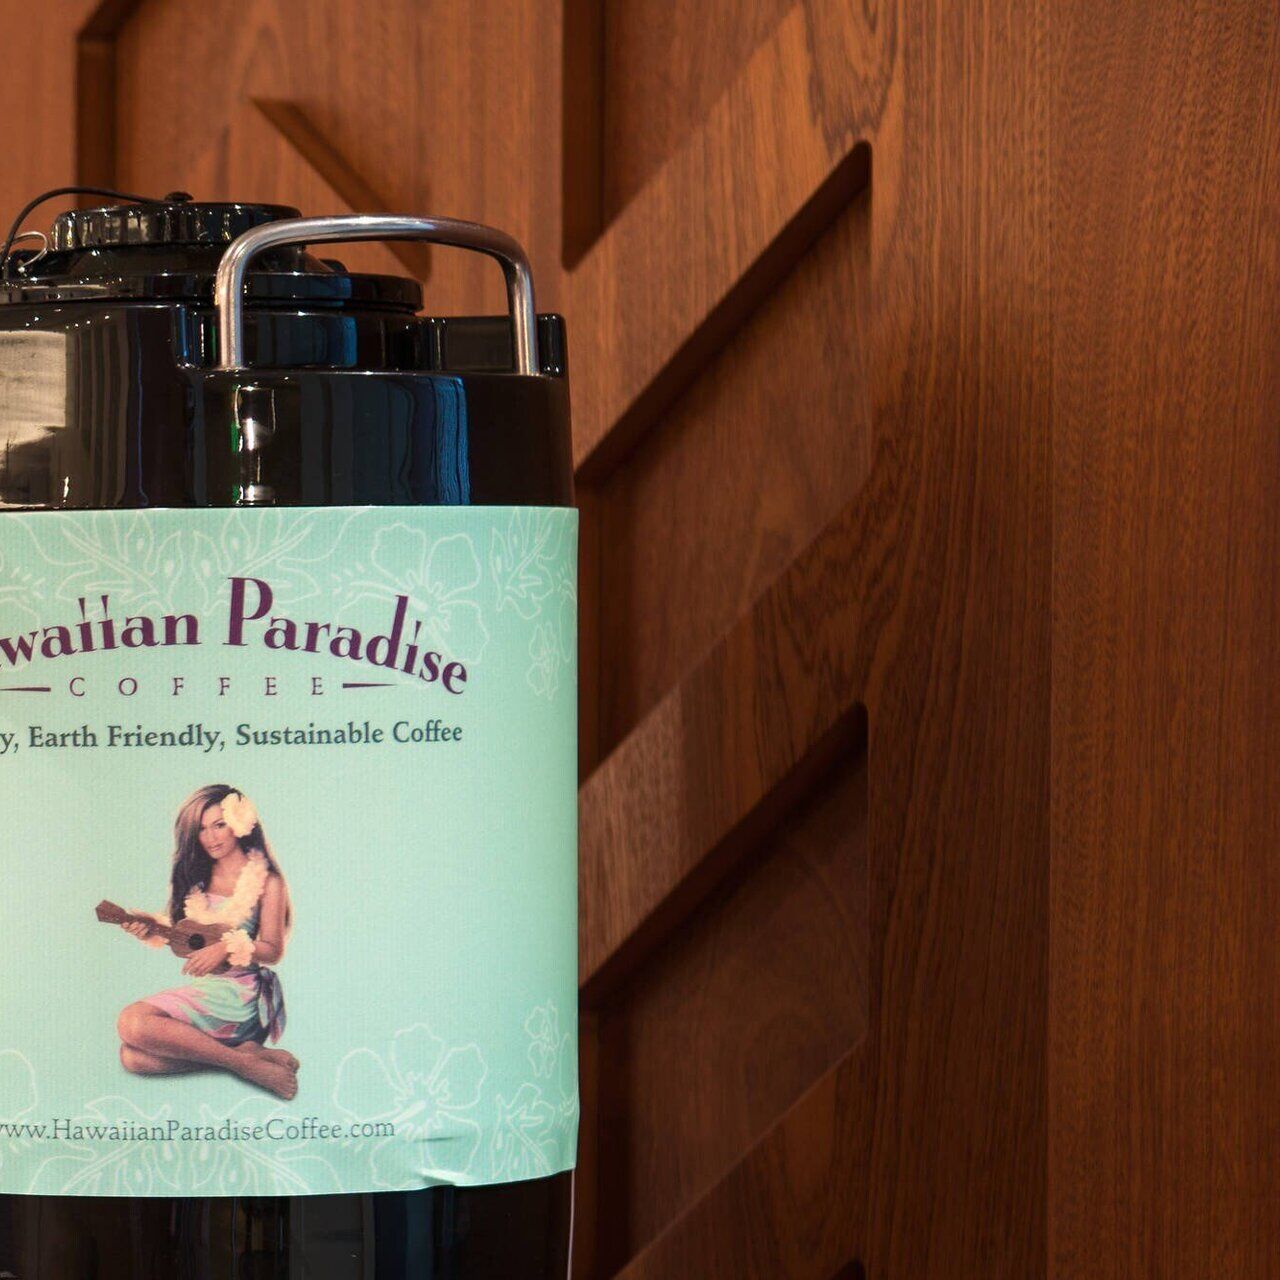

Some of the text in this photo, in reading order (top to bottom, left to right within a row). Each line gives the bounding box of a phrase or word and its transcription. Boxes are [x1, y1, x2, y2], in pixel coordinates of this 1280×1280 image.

[222, 576, 468, 695] Paradise
[69, 677, 323, 696] COFFEE
[29, 725, 97, 747] Earth
[107, 723, 226, 753] Friendly,
[236, 722, 384, 747] Sustainable
[392, 719, 463, 743] Coffee
